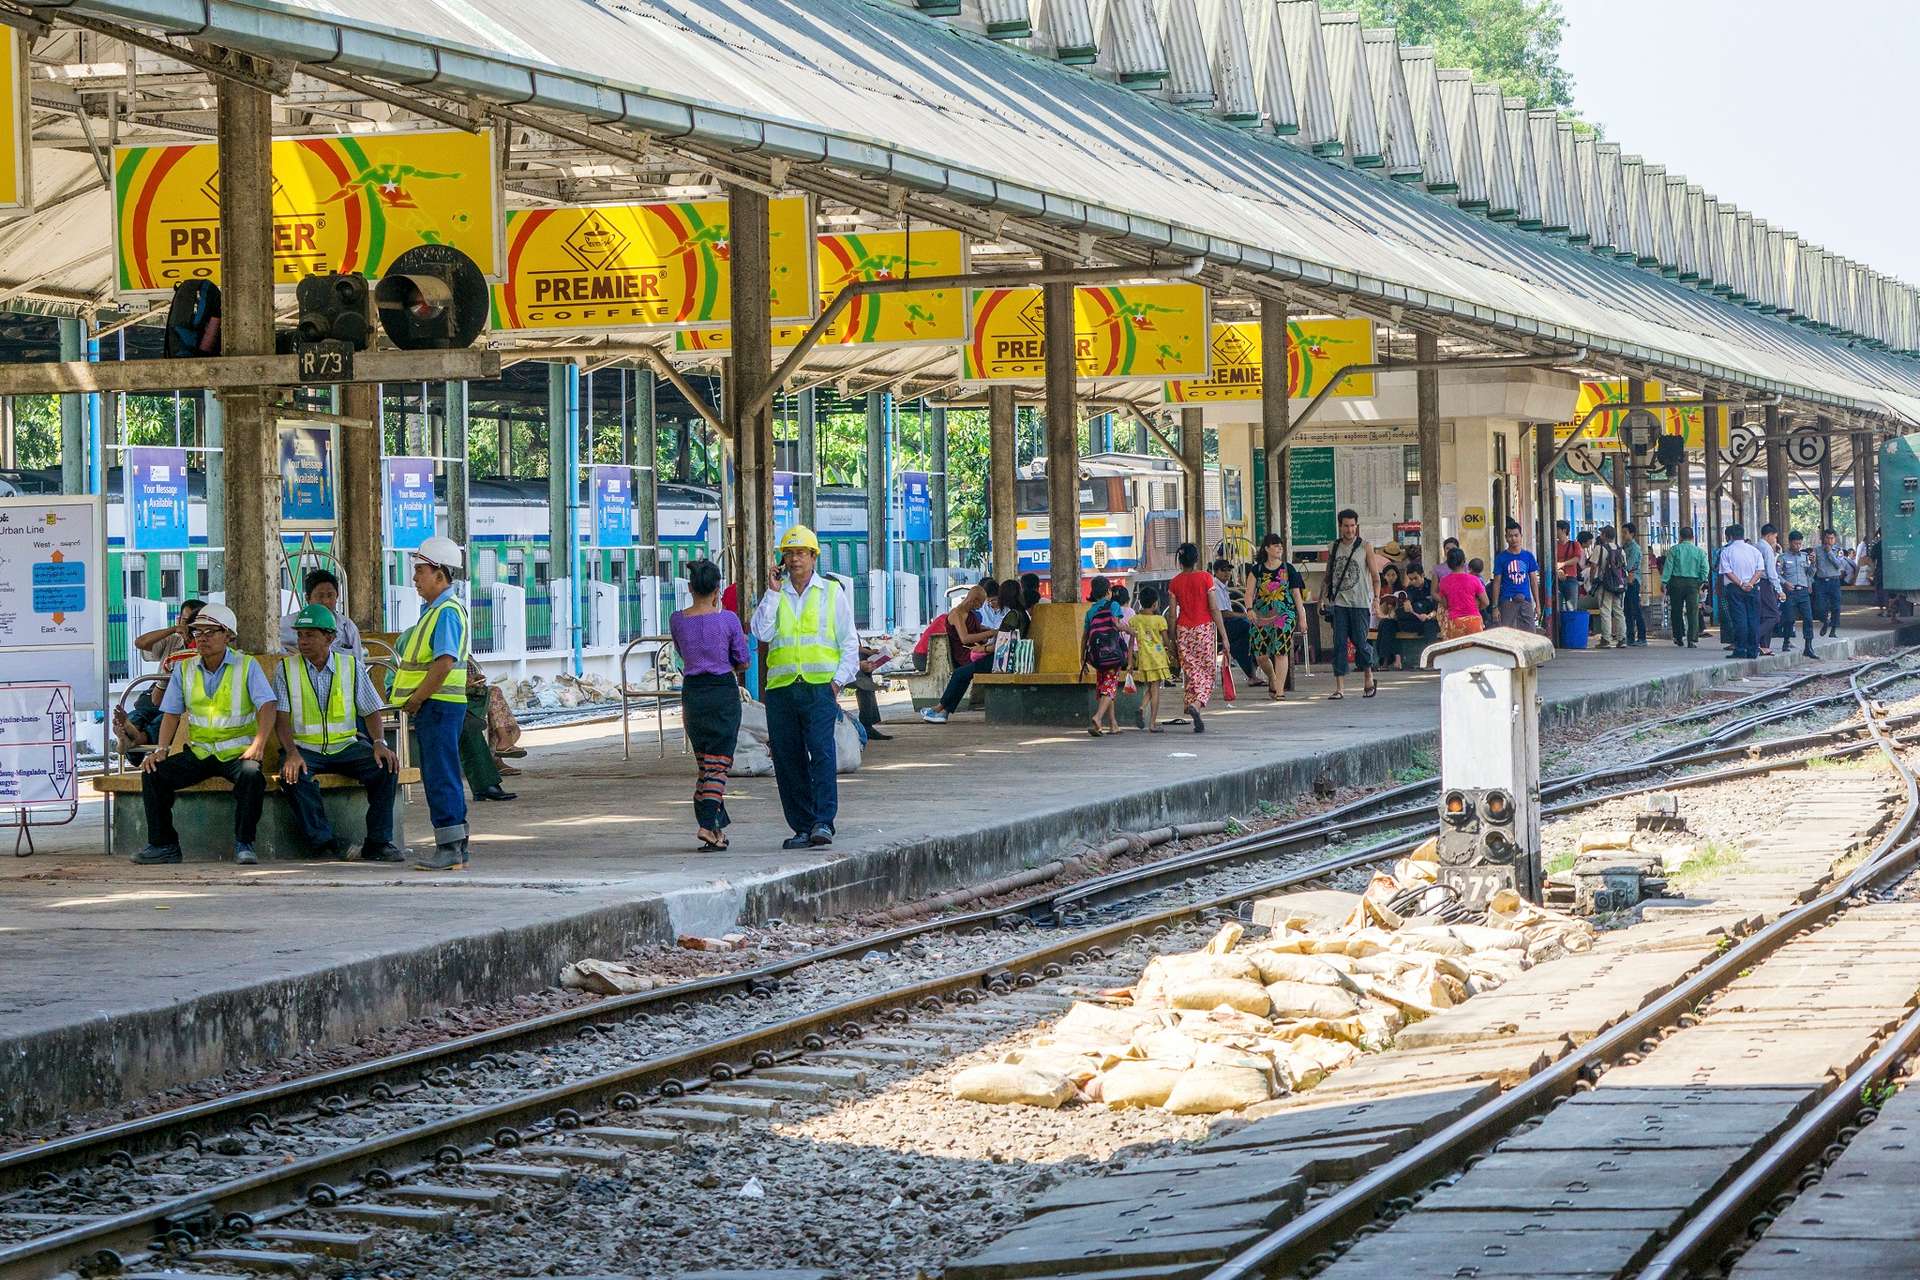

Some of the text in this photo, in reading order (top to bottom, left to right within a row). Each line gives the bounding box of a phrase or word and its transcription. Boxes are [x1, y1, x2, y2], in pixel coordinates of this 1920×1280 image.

[170, 223, 317, 257] PRER
[161, 262, 328, 279] COEE
[535, 274, 660, 302] PREMIER
[528, 306, 669, 321] COFFEE
[708, 328, 836, 342] CFE
[996, 338, 1092, 359] PRER
[991, 363, 1099, 374] COFE
[1193, 367, 1262, 385] EMIE
[1188, 387, 1263, 397] COFFE
[1800, 433, 1818, 461] 6
[143, 484, 178, 496] Your Message
[1464, 514, 1480, 523] OK
[26, 525, 45, 534] Line
[55, 711, 63, 735] West
[56, 760, 65, 781] East
